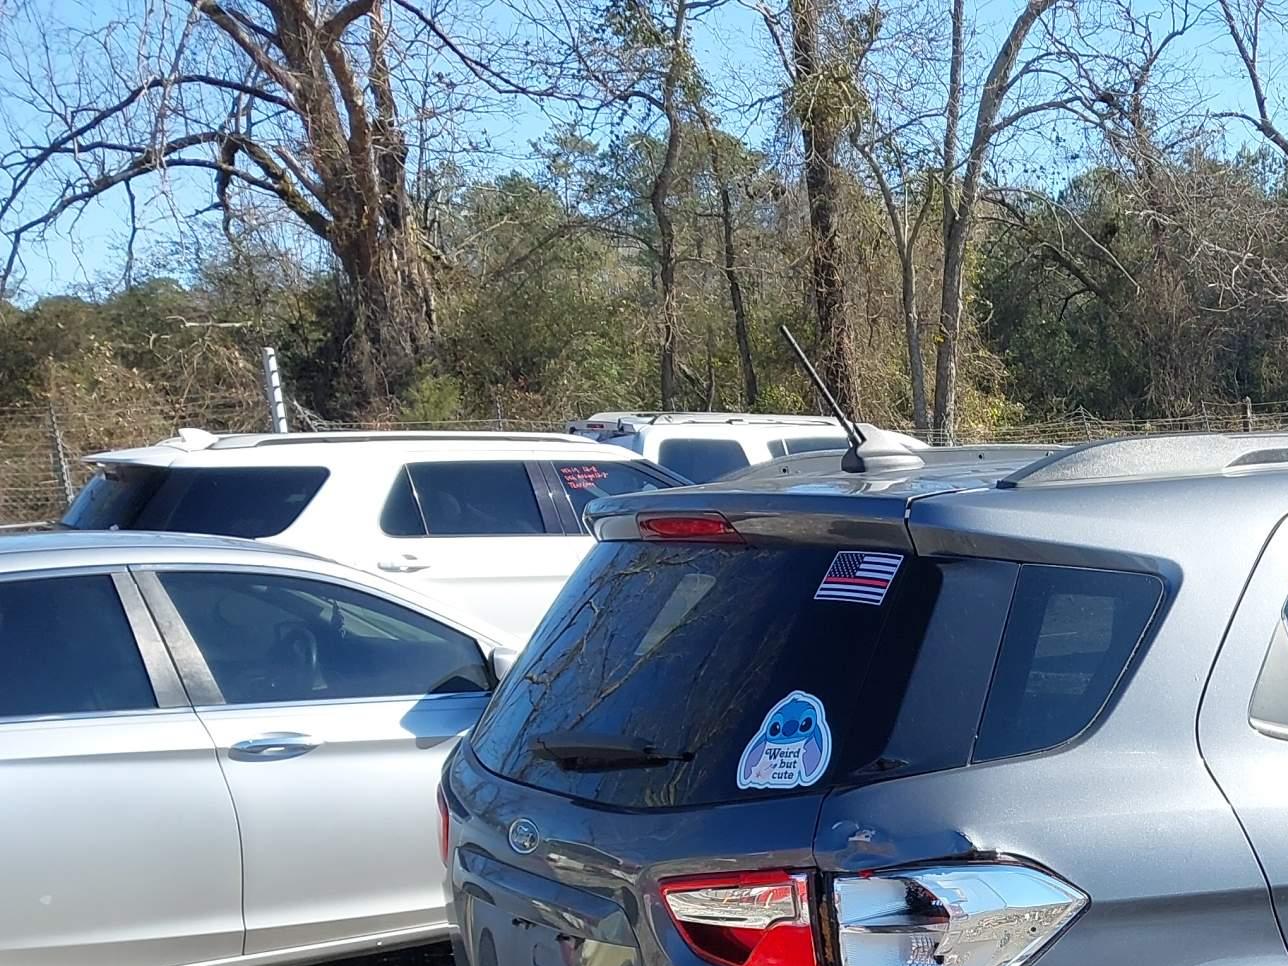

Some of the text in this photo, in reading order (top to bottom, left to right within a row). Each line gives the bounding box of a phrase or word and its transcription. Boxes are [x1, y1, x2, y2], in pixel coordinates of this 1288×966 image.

[765, 747, 801, 760] Weird
[779, 759, 797, 768] but
[771, 770, 794, 780] cute
